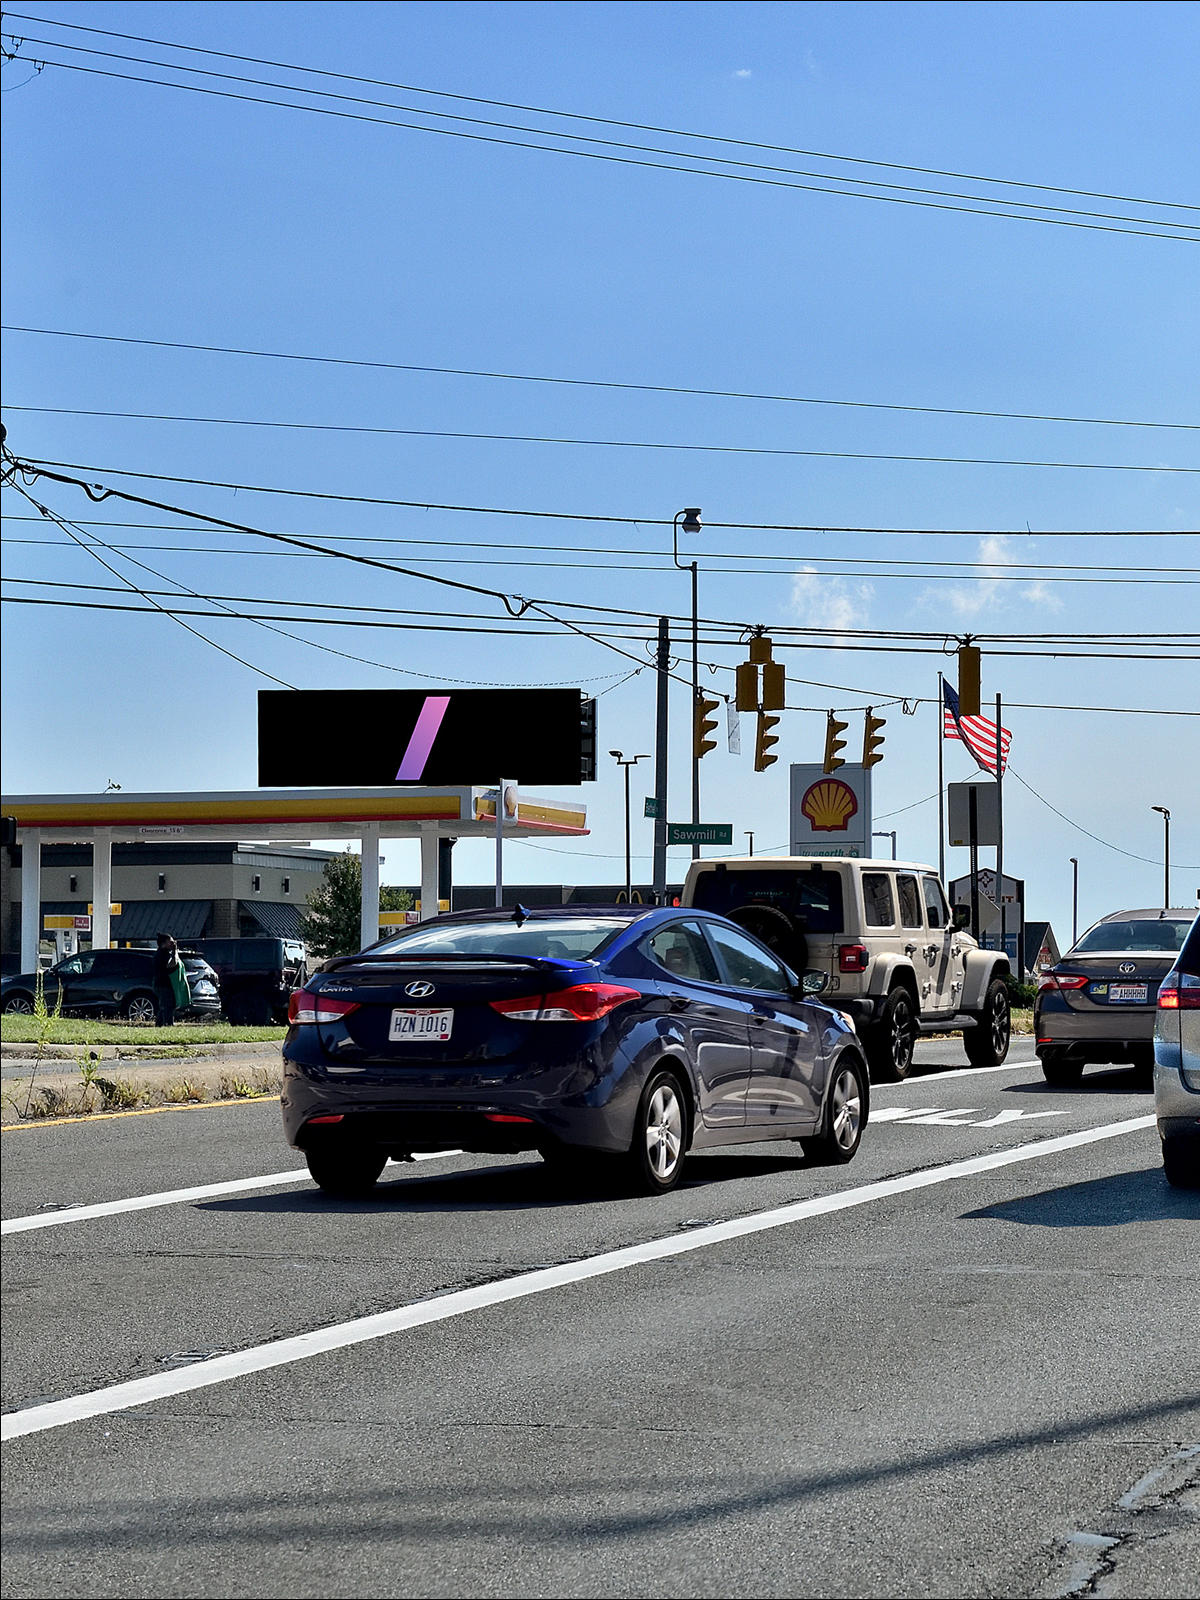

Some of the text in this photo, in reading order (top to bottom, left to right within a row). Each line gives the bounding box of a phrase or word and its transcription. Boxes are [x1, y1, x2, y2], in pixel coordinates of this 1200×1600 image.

[673, 829, 716, 840] Sawmill
[393, 1016, 449, 1033] HZN 1016
